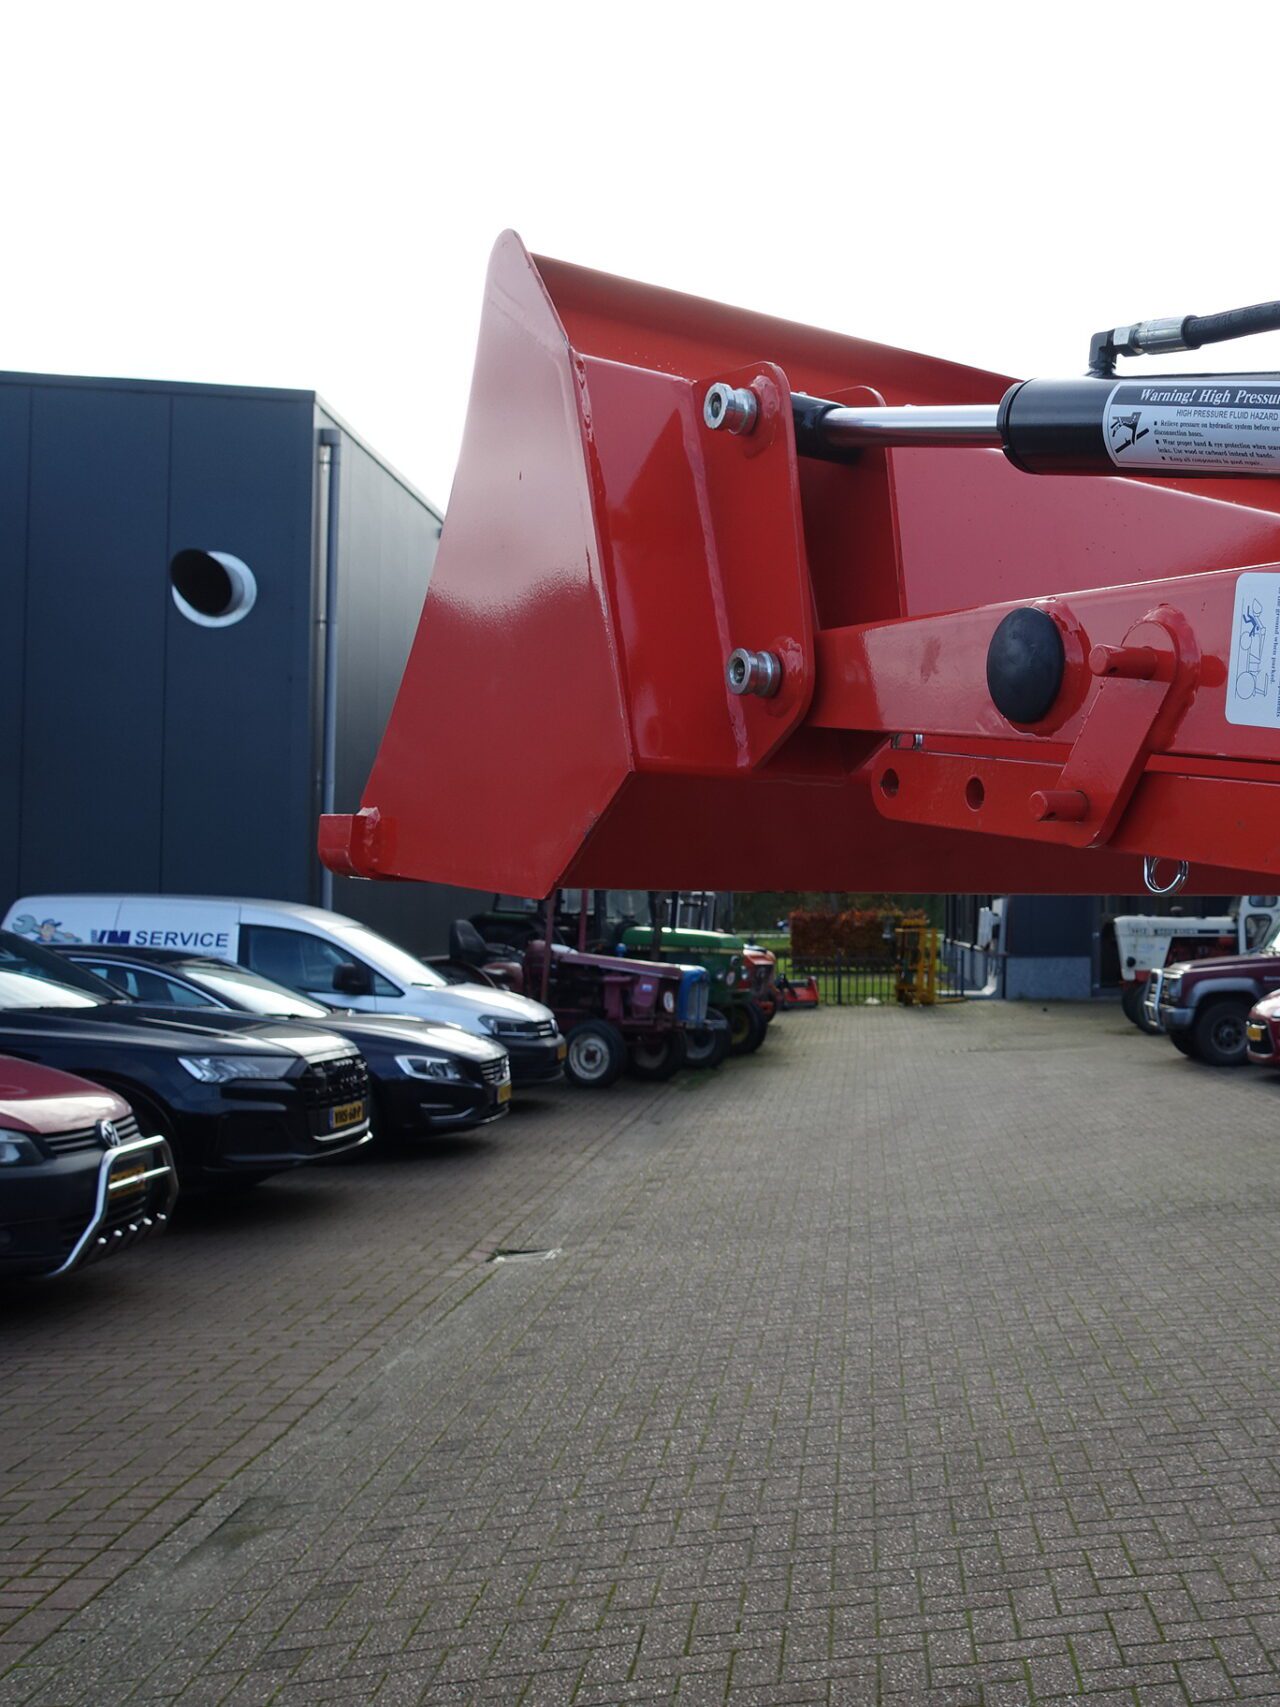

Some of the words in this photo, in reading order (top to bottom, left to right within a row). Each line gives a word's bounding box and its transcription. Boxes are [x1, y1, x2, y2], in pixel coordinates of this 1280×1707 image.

[1140, 388, 1197, 404] Warning!
[1197, 388, 1231, 405] High
[1175, 408, 1193, 417] HIGH
[1192, 408, 1228, 419] PRESSURE
[1228, 410, 1249, 420] FLUID
[1249, 410, 1279, 421] HAZARD
[135, 930, 230, 948] SERVICE
